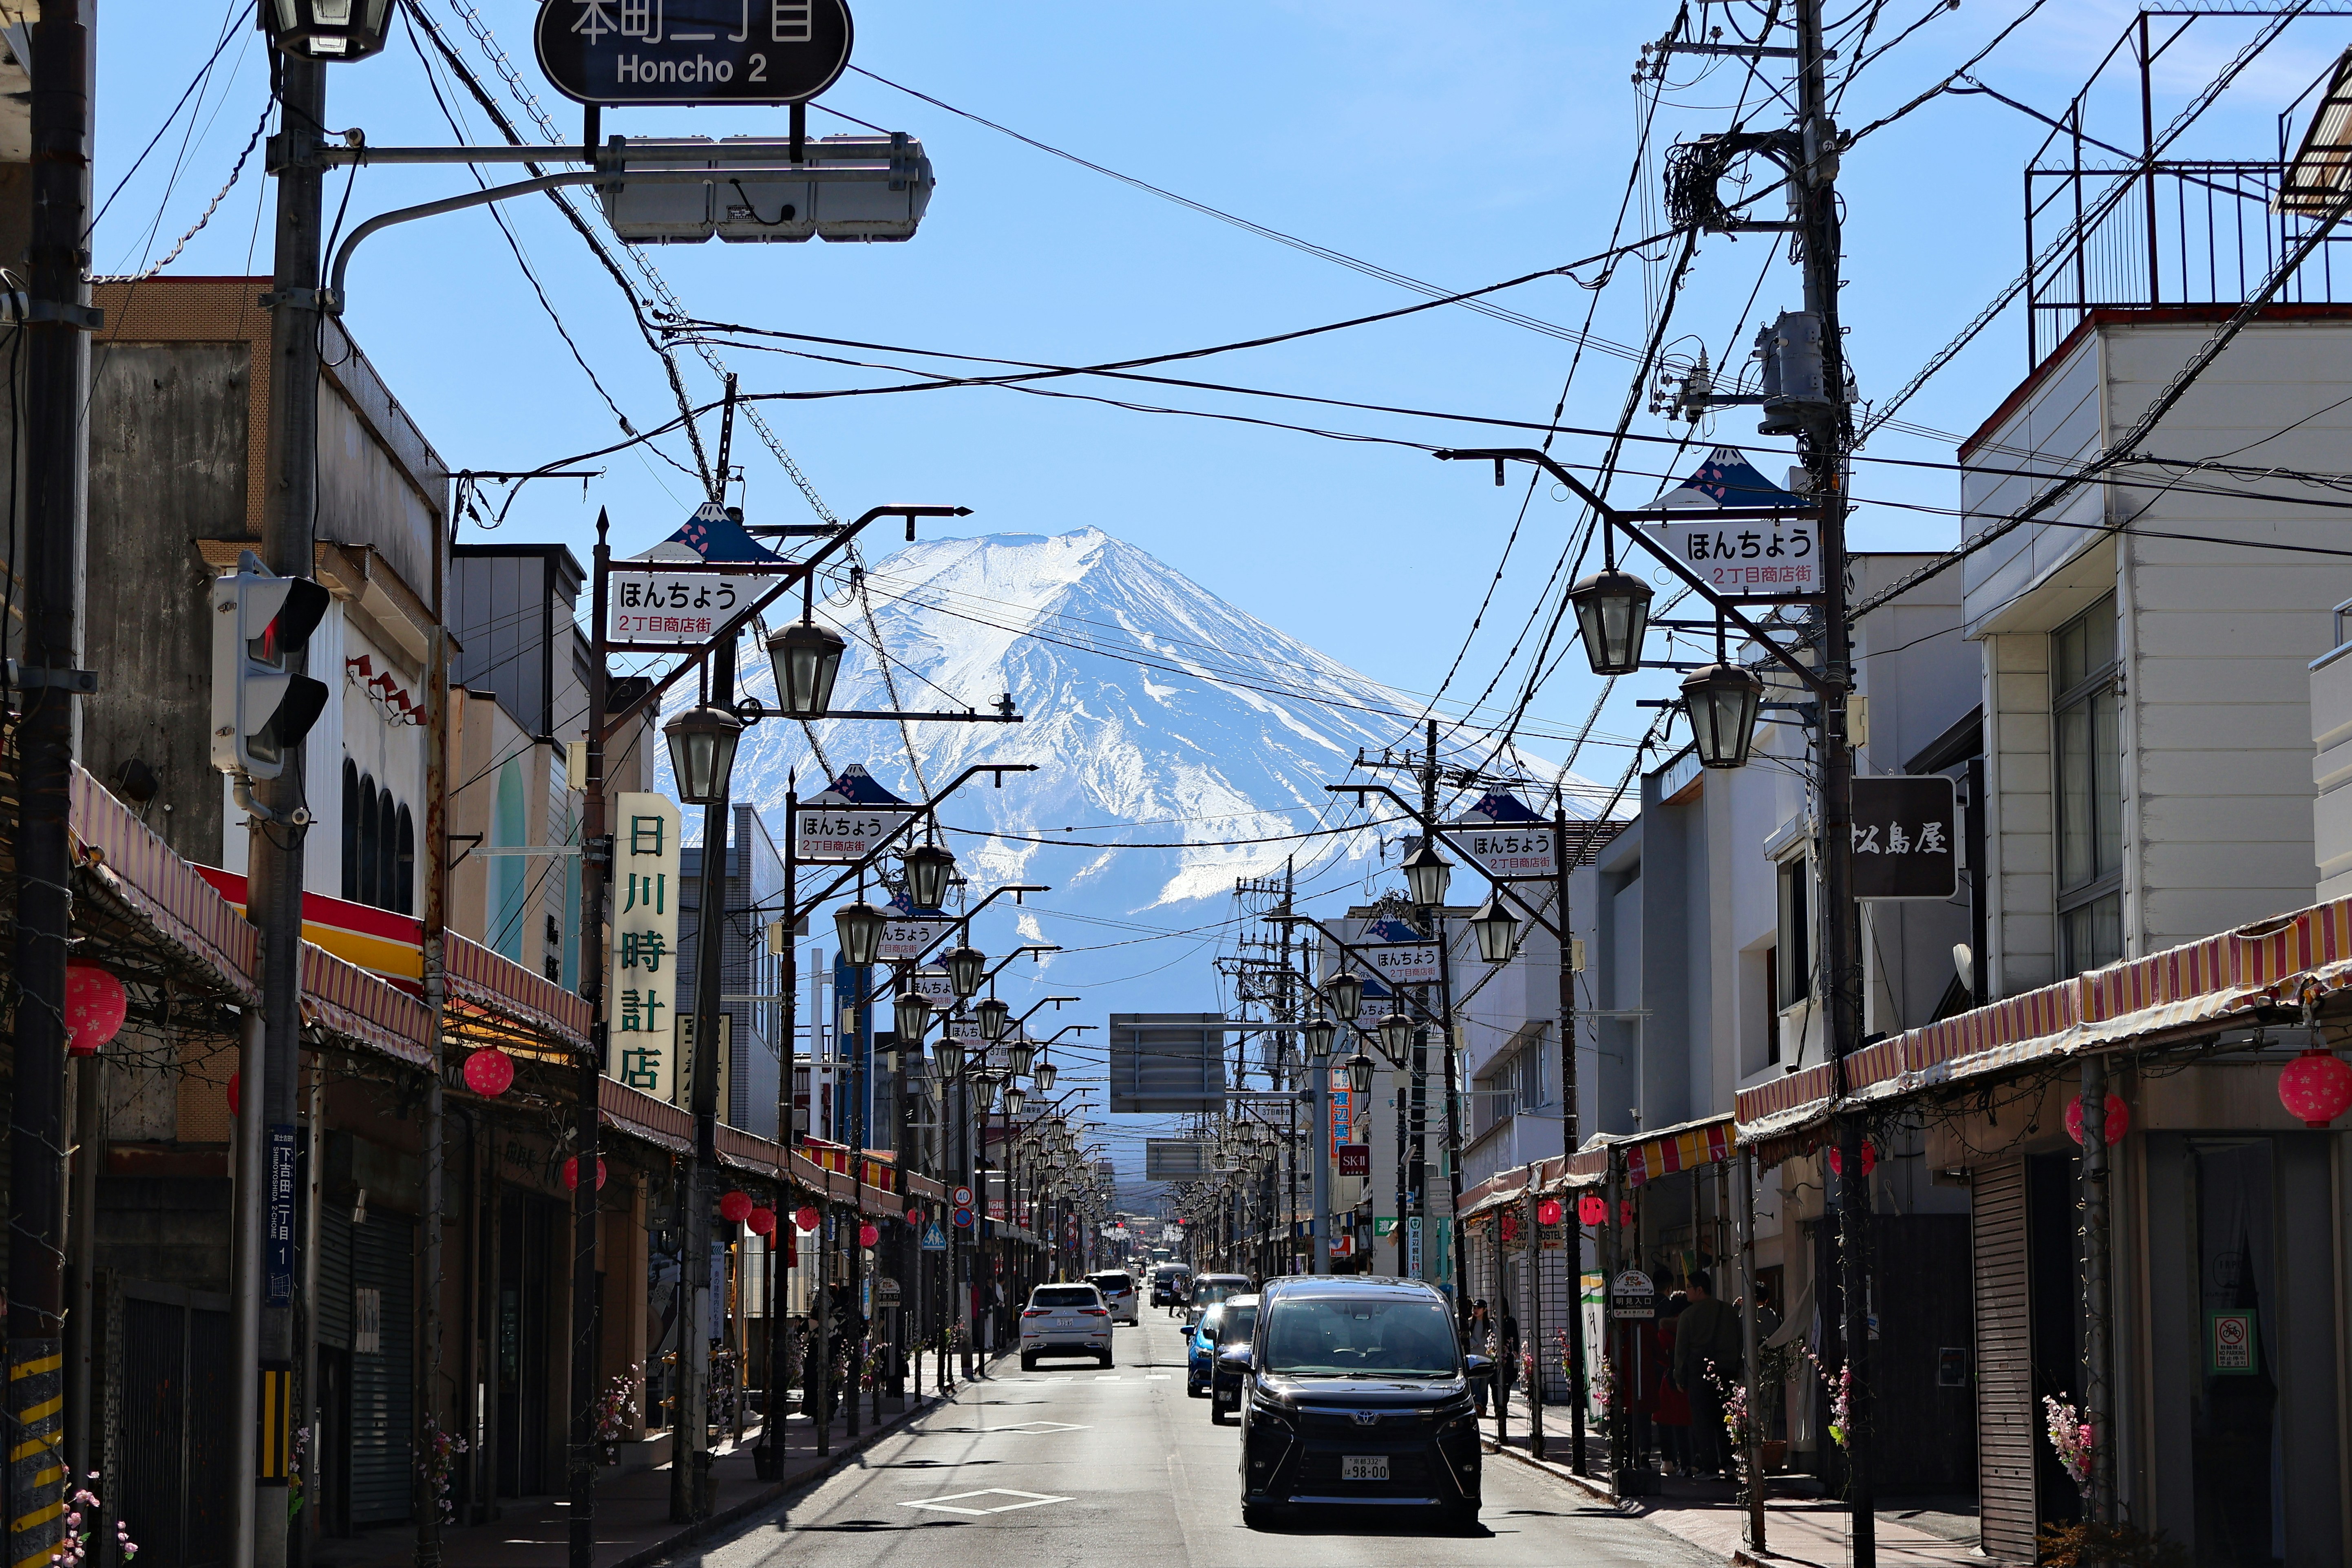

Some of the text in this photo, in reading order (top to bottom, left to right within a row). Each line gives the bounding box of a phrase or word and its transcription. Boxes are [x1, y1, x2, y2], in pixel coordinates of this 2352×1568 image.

[617, 53, 767, 83] Honcho 2
[1688, 529, 1811, 560] ほんちょう
[1714, 565, 1811, 584] 2丁目商店街
[620, 581, 736, 610] ほんちょう
[619, 615, 711, 634] 2丁目商店街
[804, 817, 881, 837] ほんちょう
[1474, 835, 1550, 855] ほんちょう
[1852, 821, 1947, 855] 松島屋
[802, 840, 865, 852] 2丁目商店街
[1491, 856, 1550, 869] 2丁目商店街
[881, 927, 930, 942] んちょう
[620, 815, 666, 1090] 日川時計店
[878, 944, 917, 953] 丁目商店街
[1378, 950, 1435, 966] ほんちょう
[1390, 967, 1435, 977] 2丁目商店街
[914, 982, 951, 994] ほんちょ
[1359, 1004, 1394, 1016] んちょう
[953, 1027, 982, 1037] ほんち
[1343, 1155, 1365, 1166] SK-II
[958, 1192, 968, 1201] 40
[278, 1147, 292, 1265] 下吉田二丁目 1
[1541, 1231, 1561, 1239] OSTEL
[1353, 1466, 1386, 1478] 98-00
